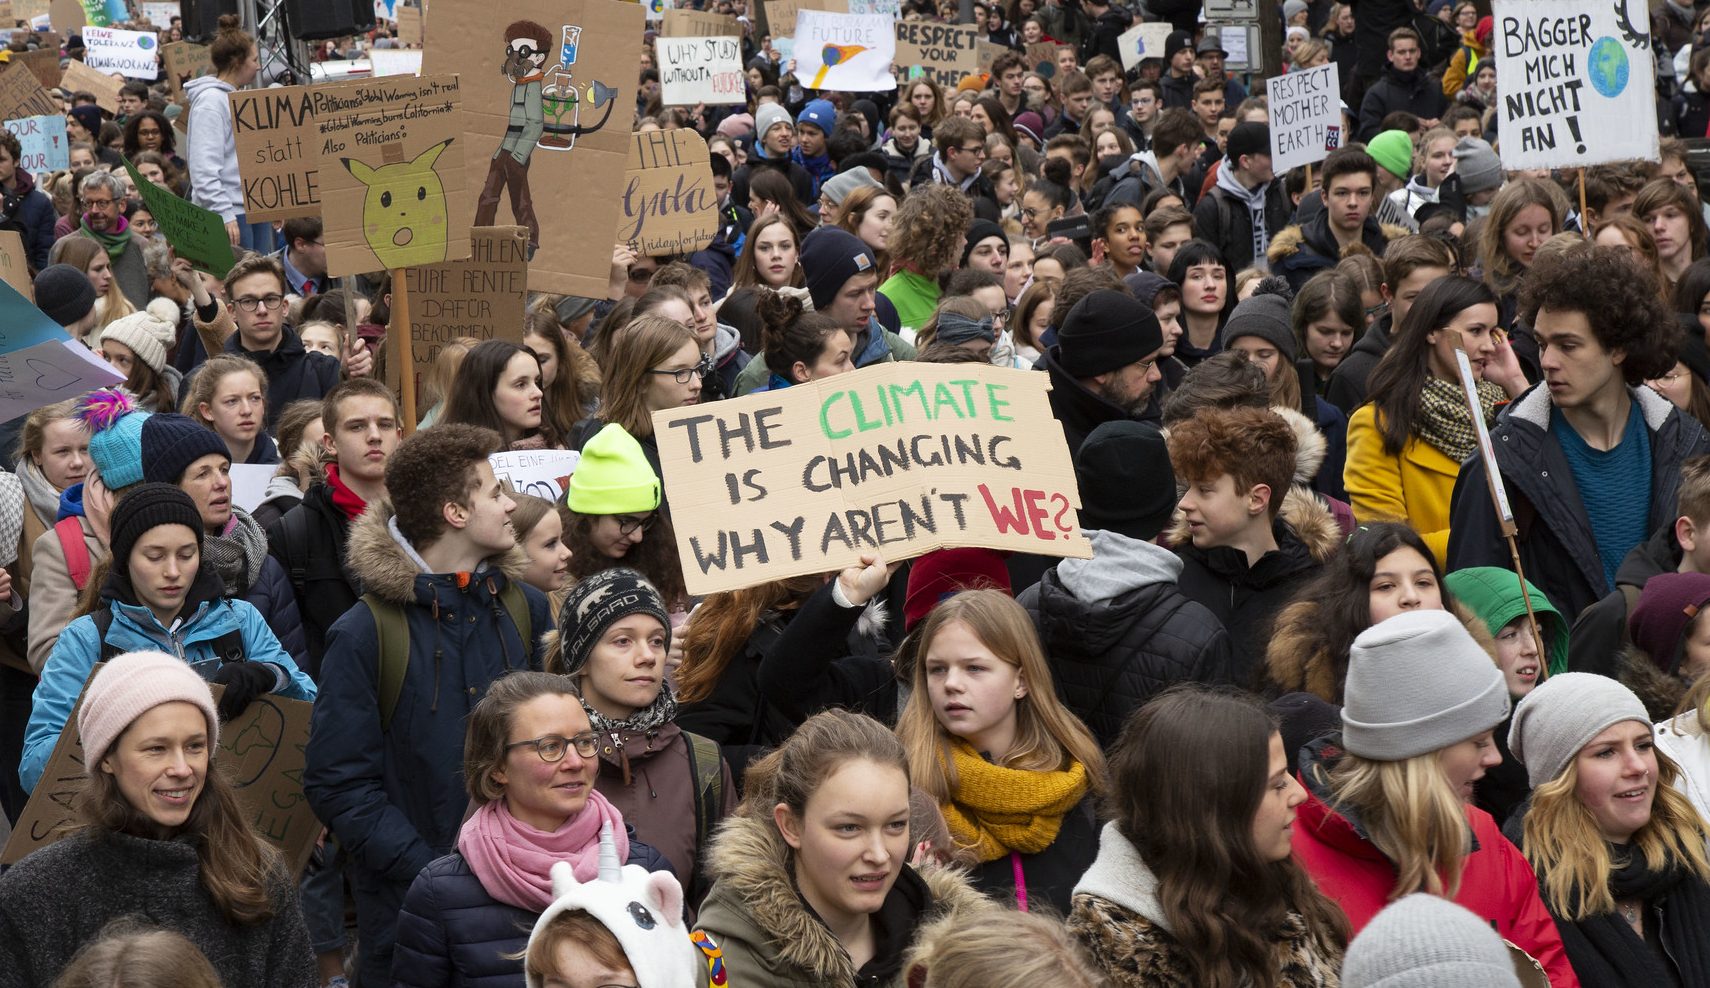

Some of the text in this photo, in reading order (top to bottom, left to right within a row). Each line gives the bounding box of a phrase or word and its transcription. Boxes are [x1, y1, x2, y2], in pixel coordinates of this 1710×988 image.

[87, 39, 135, 48] TOLERANZ
[812, 27, 875, 43] FUTURE
[897, 23, 978, 50] RESPECT
[1502, 13, 1594, 58] BAGGER
[668, 40, 738, 64] WHY STUDY
[919, 48, 957, 62] YOUR
[664, 67, 704, 84] WITHOUT
[1525, 53, 1575, 85] MICH
[442, 76, 459, 93] real
[1272, 67, 1330, 102] RESPECT
[233, 91, 314, 133] KLIMA
[1274, 95, 1329, 128] MOTHER
[1505, 79, 1583, 122] NICHT
[9, 120, 40, 136] OUR
[1278, 124, 1324, 156] EARTH
[255, 139, 303, 165] statt
[322, 138, 346, 155] Also
[636, 129, 693, 170] THE
[21, 153, 49, 170] OUR
[243, 170, 321, 211] KOHLE
[405, 268, 524, 299] EURE RENTE,
[421, 298, 492, 319] DAFÜR
[411, 323, 494, 343] BEKOMMEN
[668, 379, 1015, 464] THE CLIMATE
[724, 433, 1023, 505] IS CHANGING
[689, 483, 1074, 576] WHY AREN'T WE?
